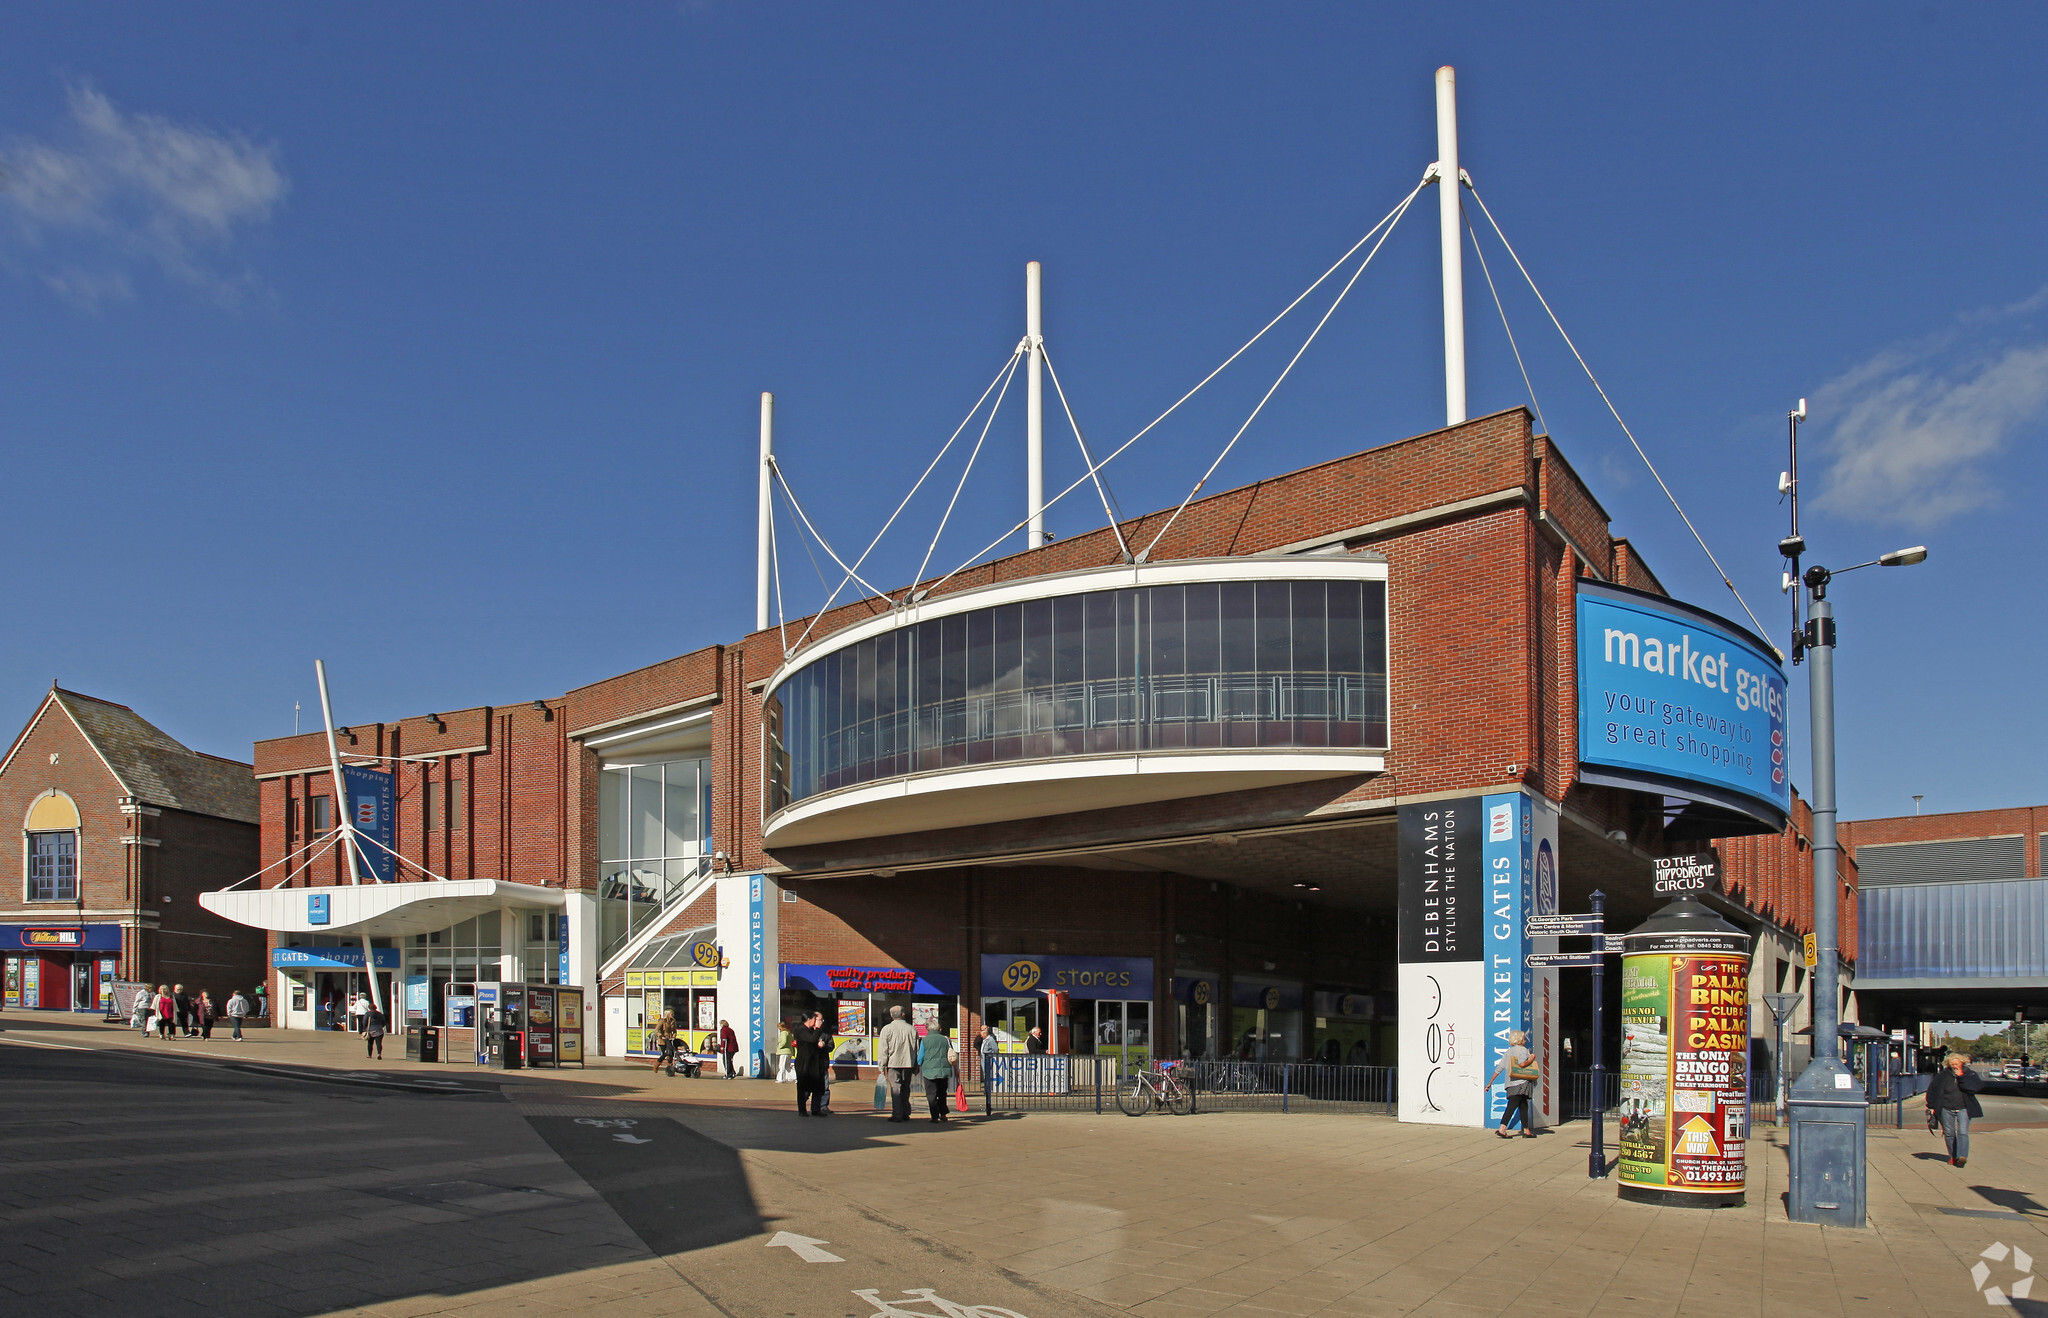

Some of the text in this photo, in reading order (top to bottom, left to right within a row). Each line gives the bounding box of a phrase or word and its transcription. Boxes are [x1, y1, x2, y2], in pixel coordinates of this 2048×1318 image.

[1604, 628, 1784, 724] market gates
[1604, 690, 1752, 744] your gateway to
[1606, 722, 1753, 776] great shopping
[345, 768, 390, 785] shopping
[382, 787, 390, 821] GATES
[1654, 856, 1696, 868] TO THE
[1656, 864, 1714, 880] HIPPODROME
[1424, 812, 1440, 952] DEBENHAMS
[1444, 810, 1456, 952] STYLING THE NATION
[1540, 851, 1552, 915] Boots
[1655, 878, 1704, 892] CIRCUS
[1492, 857, 1511, 940] GATES
[30, 931, 76, 944] William HILL
[282, 952, 309, 961] GATES
[320, 952, 384, 964] shoppig
[699, 944, 718, 964] 99p
[826, 968, 916, 980] quality products
[1721, 964, 1739, 973] THE
[752, 911, 761, 1043] MARKET GATES
[1008, 964, 1130, 988] 99p stores
[1692, 975, 1748, 988] PALAC
[830, 978, 862, 989] under
[874, 980, 912, 992] pound!
[1711, 1006, 1743, 1016] CLUB &
[1690, 1017, 1747, 1031] PALAC
[1446, 1023, 1456, 1064] look
[1688, 1033, 1747, 1049] CASIN
[1699, 1051, 1731, 1061] ONLY
[1676, 1062, 1729, 1074] BINGO
[1675, 1074, 1714, 1082] CLUB
[1686, 1132, 1709, 1142] THIS
[1632, 1150, 1654, 1159] 4567
[1686, 1143, 1708, 1154] WAY
[1686, 1171, 1722, 1181] 01493
